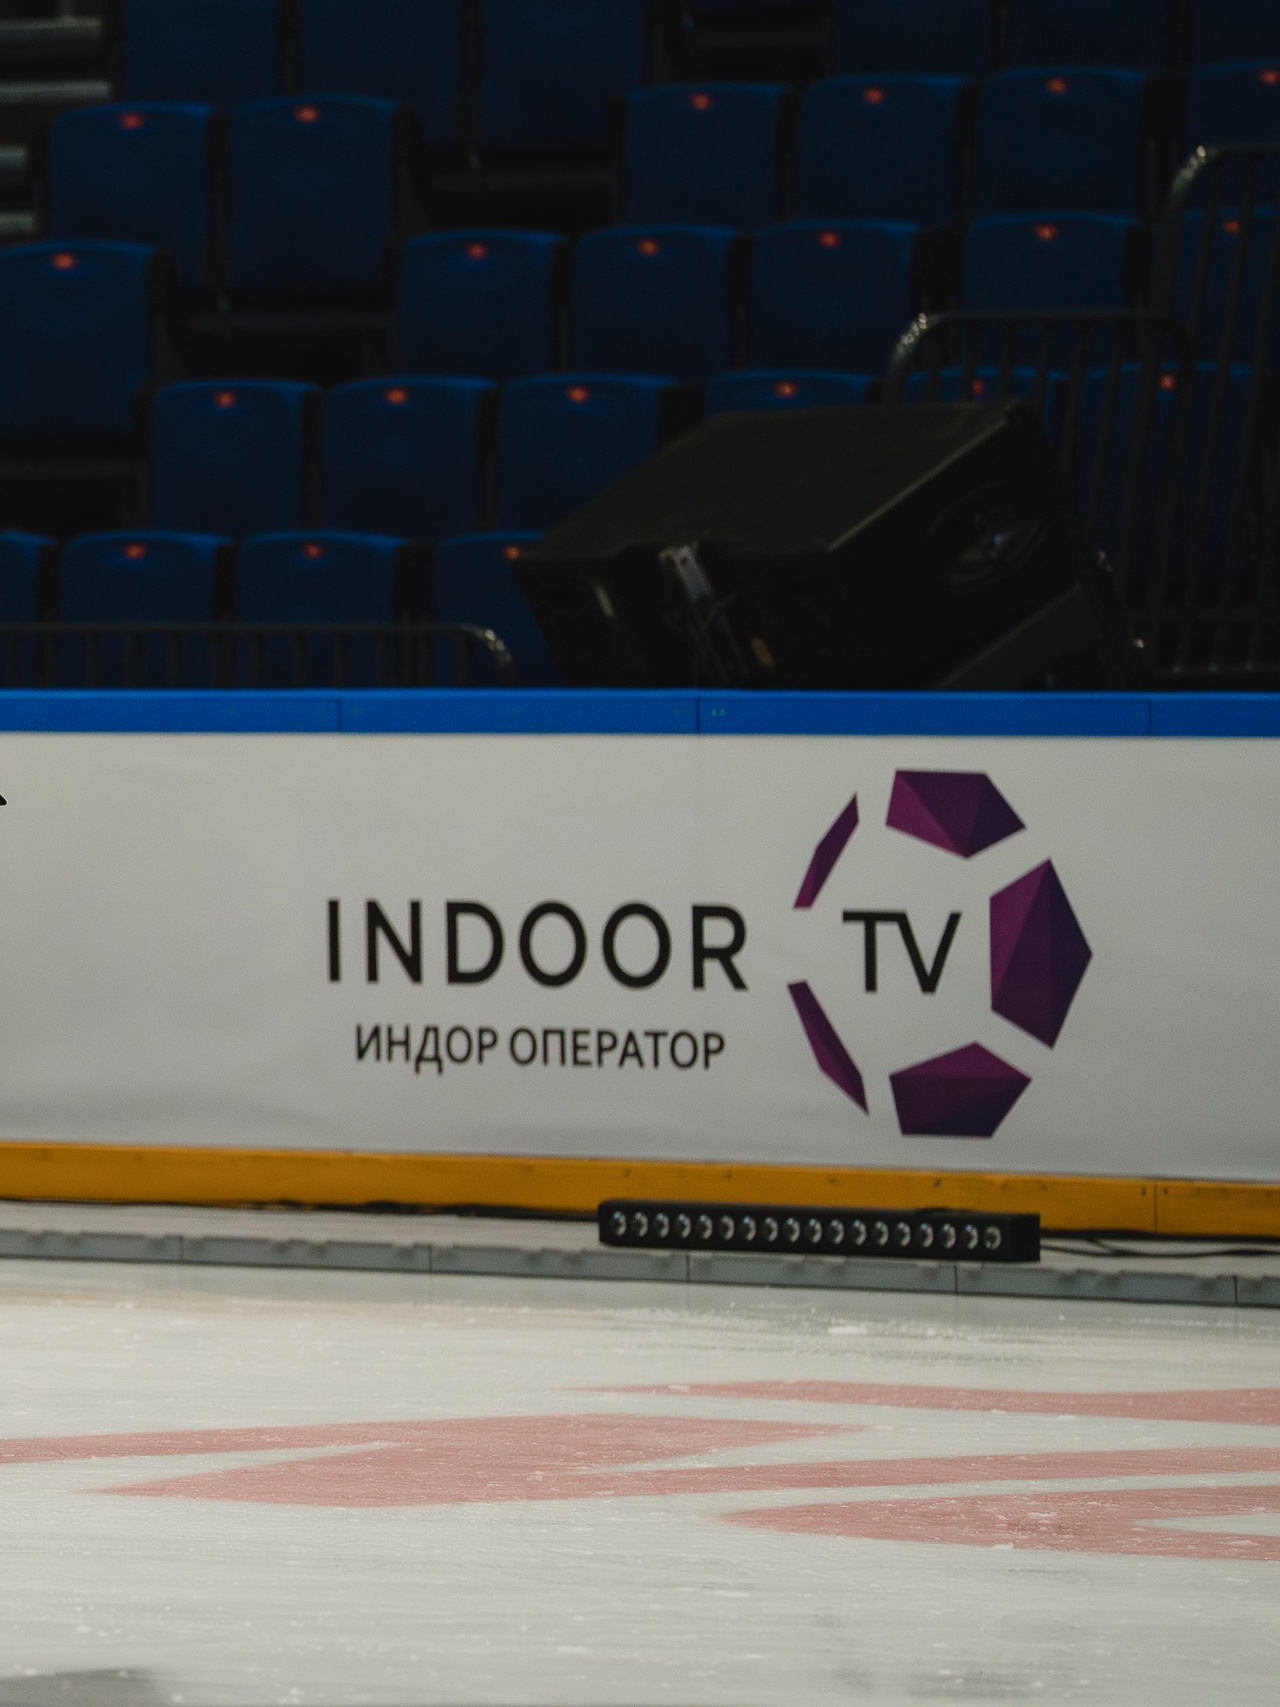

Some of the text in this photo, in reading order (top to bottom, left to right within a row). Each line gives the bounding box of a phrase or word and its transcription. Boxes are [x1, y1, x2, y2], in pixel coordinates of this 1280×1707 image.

[326, 898, 963, 995] INDOOR TV
[354, 1023, 727, 1076] ИНДОР ОПЕРАТОР
